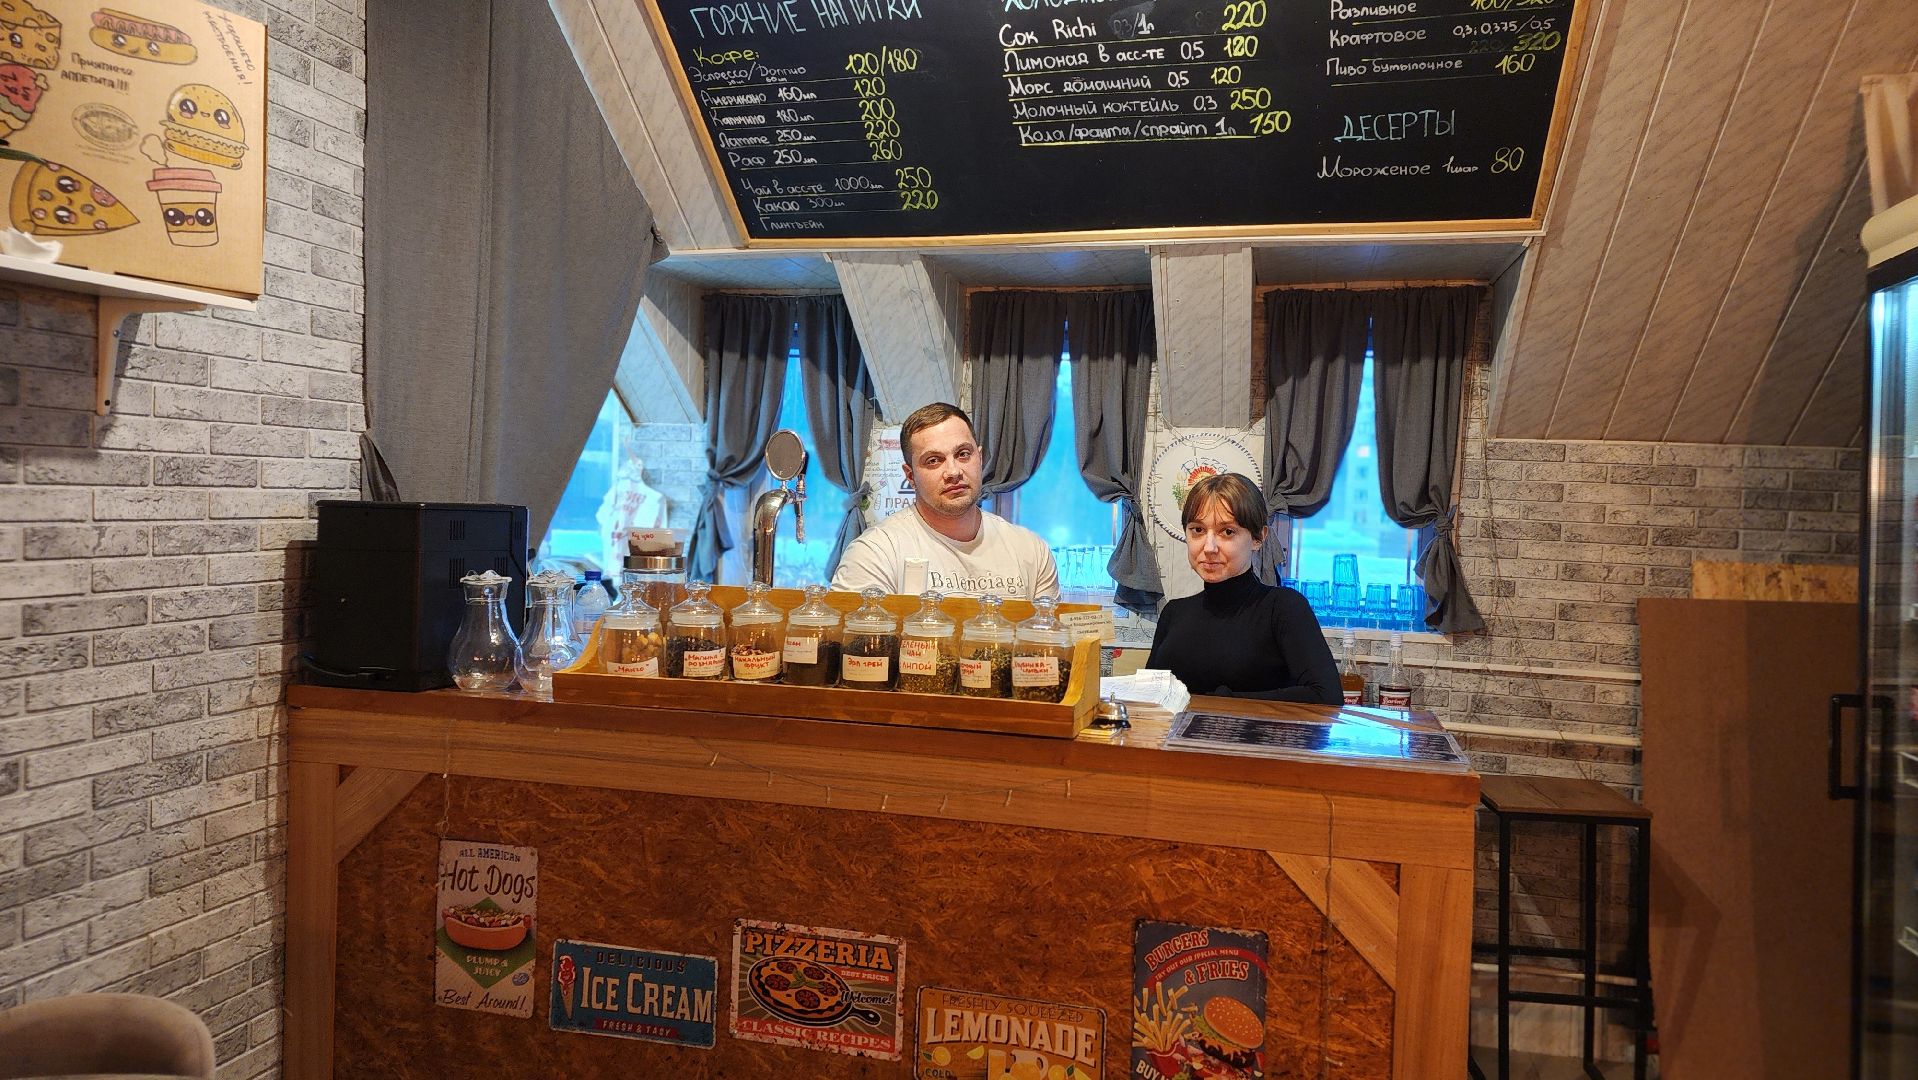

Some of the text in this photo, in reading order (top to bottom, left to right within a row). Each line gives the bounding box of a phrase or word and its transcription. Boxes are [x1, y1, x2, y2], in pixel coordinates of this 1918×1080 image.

[689, 0, 806, 38] ГОРЯЧИЕ
[999, 24, 1038, 48] Сок
[1051, 17, 1097, 40] Richi
[1221, 1, 1267, 31] 220
[1330, 0, 1417, 20] Разливное
[1330, 29, 1427, 48] Крафтовое
[693, 46, 760, 67] Кофе:
[845, 46, 918, 76] 120/180
[1003, 51, 1089, 73] Лимонад
[1098, 44, 1110, 62] в
[1180, 41, 1205, 60] 0,5
[1326, 53, 1535, 76] Пиво бутылочное 160
[700, 90, 767, 106] Американо
[854, 77, 886, 98] 120
[1006, 66, 1242, 98] Морс домашний 0,5 120
[858, 97, 896, 121] 200
[1013, 100, 1098, 120] Молочный
[1193, 95, 1218, 112] 0,3
[1230, 88, 1272, 110] 250
[718, 132, 770, 148] Латте
[864, 119, 901, 140] 220
[1250, 111, 1292, 135] 150
[1334, 109, 1456, 143] ДЕСЕРТЫ
[728, 151, 767, 168] Раф
[869, 139, 903, 161] 260
[1317, 155, 1431, 179] Мороженое
[1490, 146, 1525, 174] 80
[740, 178, 772, 196] Чай
[771, 179, 784, 194] в
[895, 166, 932, 189] 250
[753, 197, 800, 214] Какао
[900, 189, 939, 210] 220
[930, 571, 1026, 594] Balenciaga
[459, 847, 520, 863] ALL AMERICAN
[439, 860, 536, 904] Hot Dogs
[466, 955, 500, 967] PLUMP
[595, 951, 688, 974] DELICIOUS
[744, 930, 893, 972] PIZZERIA
[1144, 929, 1210, 972] BURGERS
[473, 966, 502, 977] JUICY
[861, 971, 890, 983] PRICES
[1184, 959, 1250, 986] & FRIES
[442, 988, 528, 1013] Best Around!
[580, 967, 713, 1024] ICE CREAM
[840, 991, 895, 1005] Welcome!
[943, 994, 1085, 1023] FRESHLY SQUEEZED
[741, 1018, 891, 1050] CLASSIC RECIPES
[925, 1007, 1098, 1068] LEMONADE
[1136, 1060, 1160, 1080] BUY
